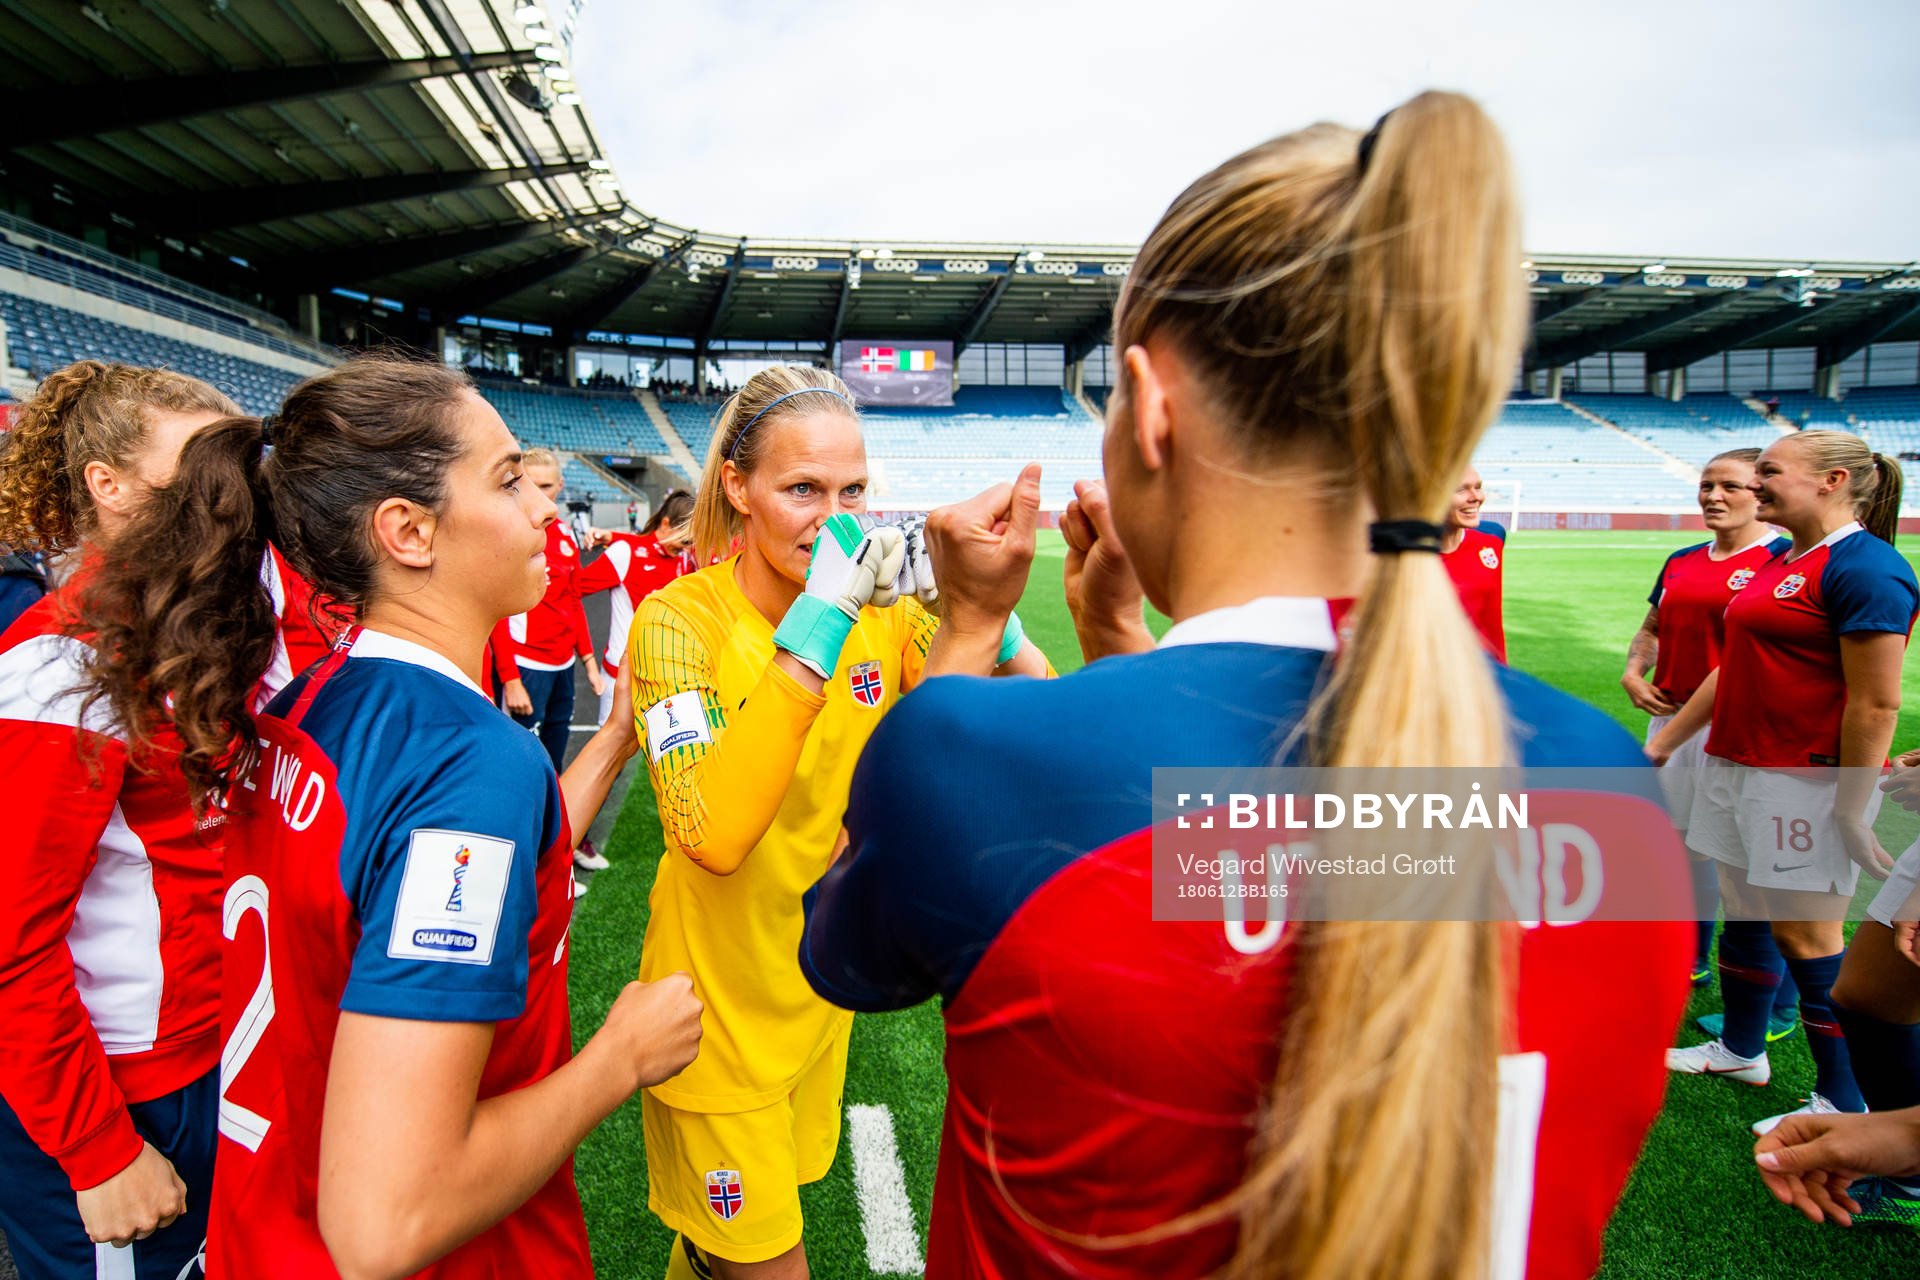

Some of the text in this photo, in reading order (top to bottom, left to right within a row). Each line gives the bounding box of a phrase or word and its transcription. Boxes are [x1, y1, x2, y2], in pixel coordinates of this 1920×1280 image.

[685, 251, 728, 268] oop
[772, 257, 819, 271] coop
[873, 259, 919, 274] coop
[943, 260, 990, 274] coop
[1033, 262, 1078, 276] coop
[1561, 271, 1605, 286] coop
[1643, 274, 1687, 288] coop
[1706, 276, 1749, 290] coop
[661, 731, 697, 749] QUALIFIERS
[1771, 817, 1813, 852] 18
[1216, 822, 1605, 955] UND
[415, 931, 475, 948] QUALIFIERS
[218, 874, 276, 1154] 2
